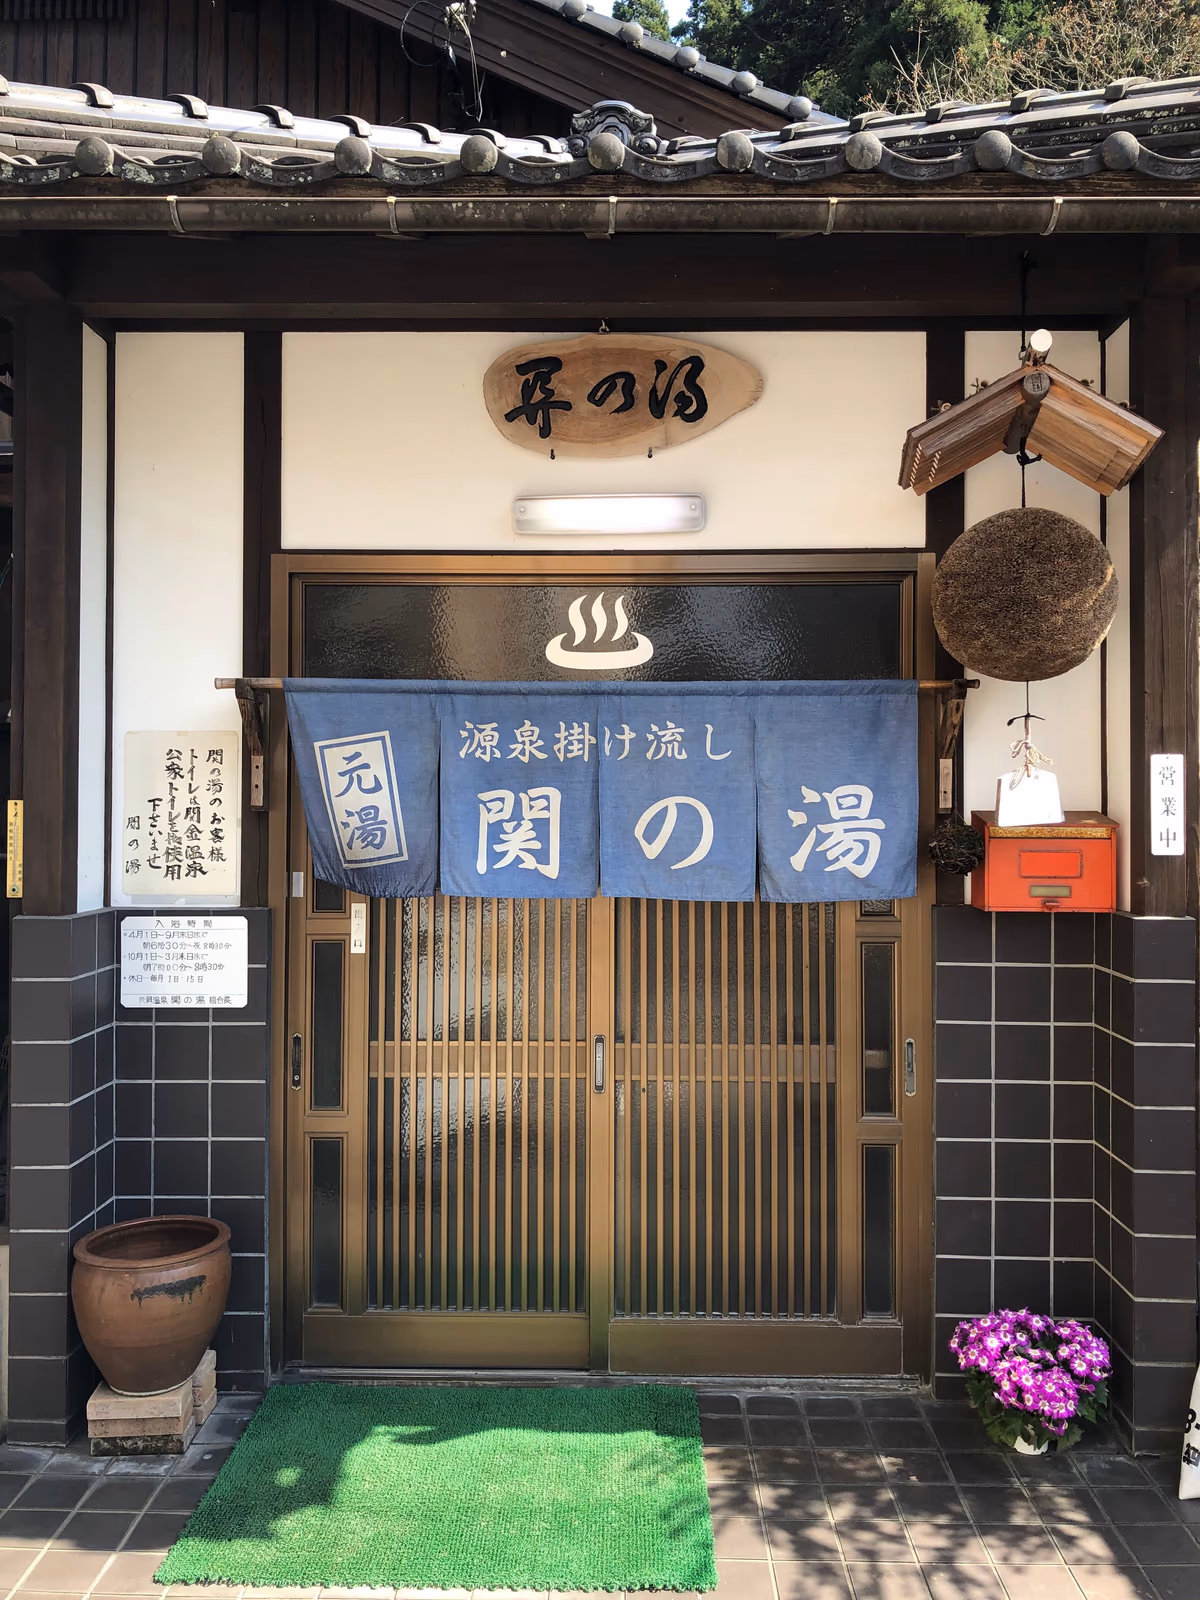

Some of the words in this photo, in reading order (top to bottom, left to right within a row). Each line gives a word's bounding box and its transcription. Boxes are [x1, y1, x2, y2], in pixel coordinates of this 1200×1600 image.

[458, 719, 733, 764] 源泉掛け流し
[333, 753, 389, 854] 元湯
[476, 784, 887, 880] 関の湯
[1158, 765, 1177, 848] 営業中
